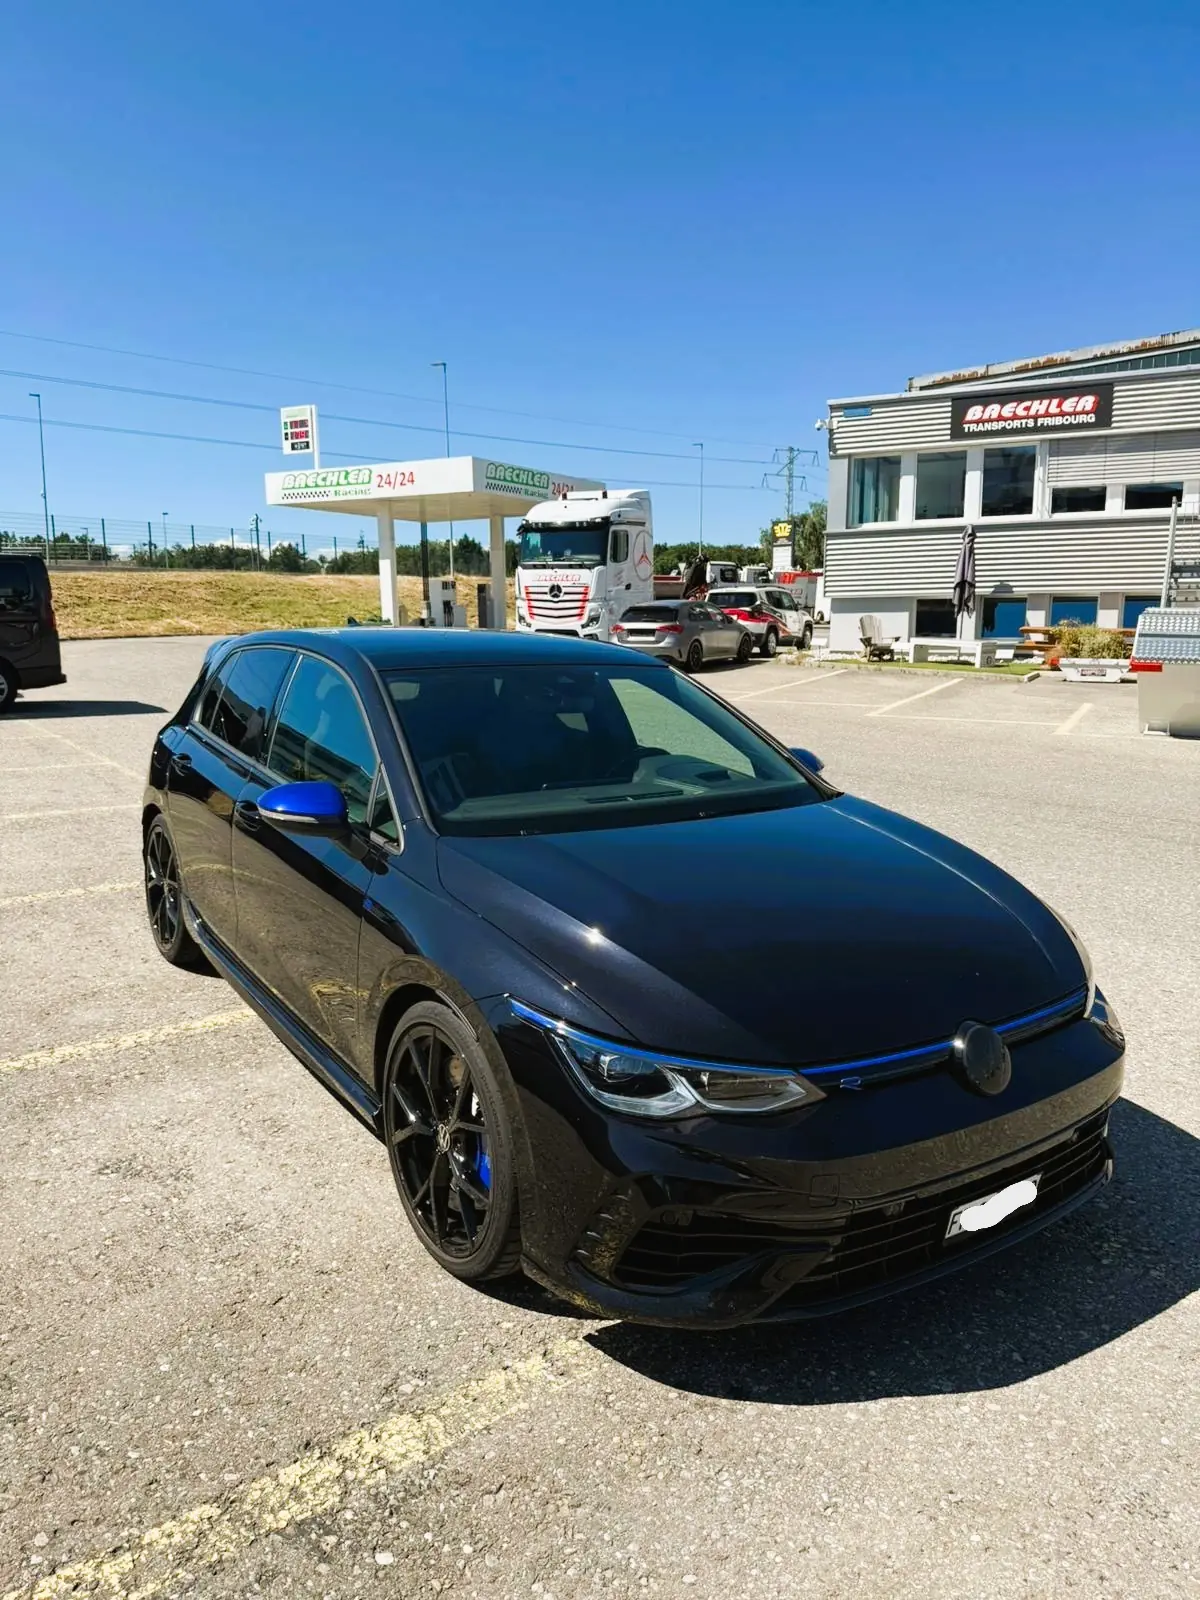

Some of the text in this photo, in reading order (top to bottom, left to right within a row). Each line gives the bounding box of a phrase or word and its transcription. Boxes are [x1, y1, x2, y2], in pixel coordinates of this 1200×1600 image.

[963, 395, 1098, 422] BAECHLER
[963, 413, 1096, 432] TRANSPORTS FRIBOURG
[282, 468, 416, 490] BAECHLER 24/24
[486, 463, 549, 489] BAECHLER
